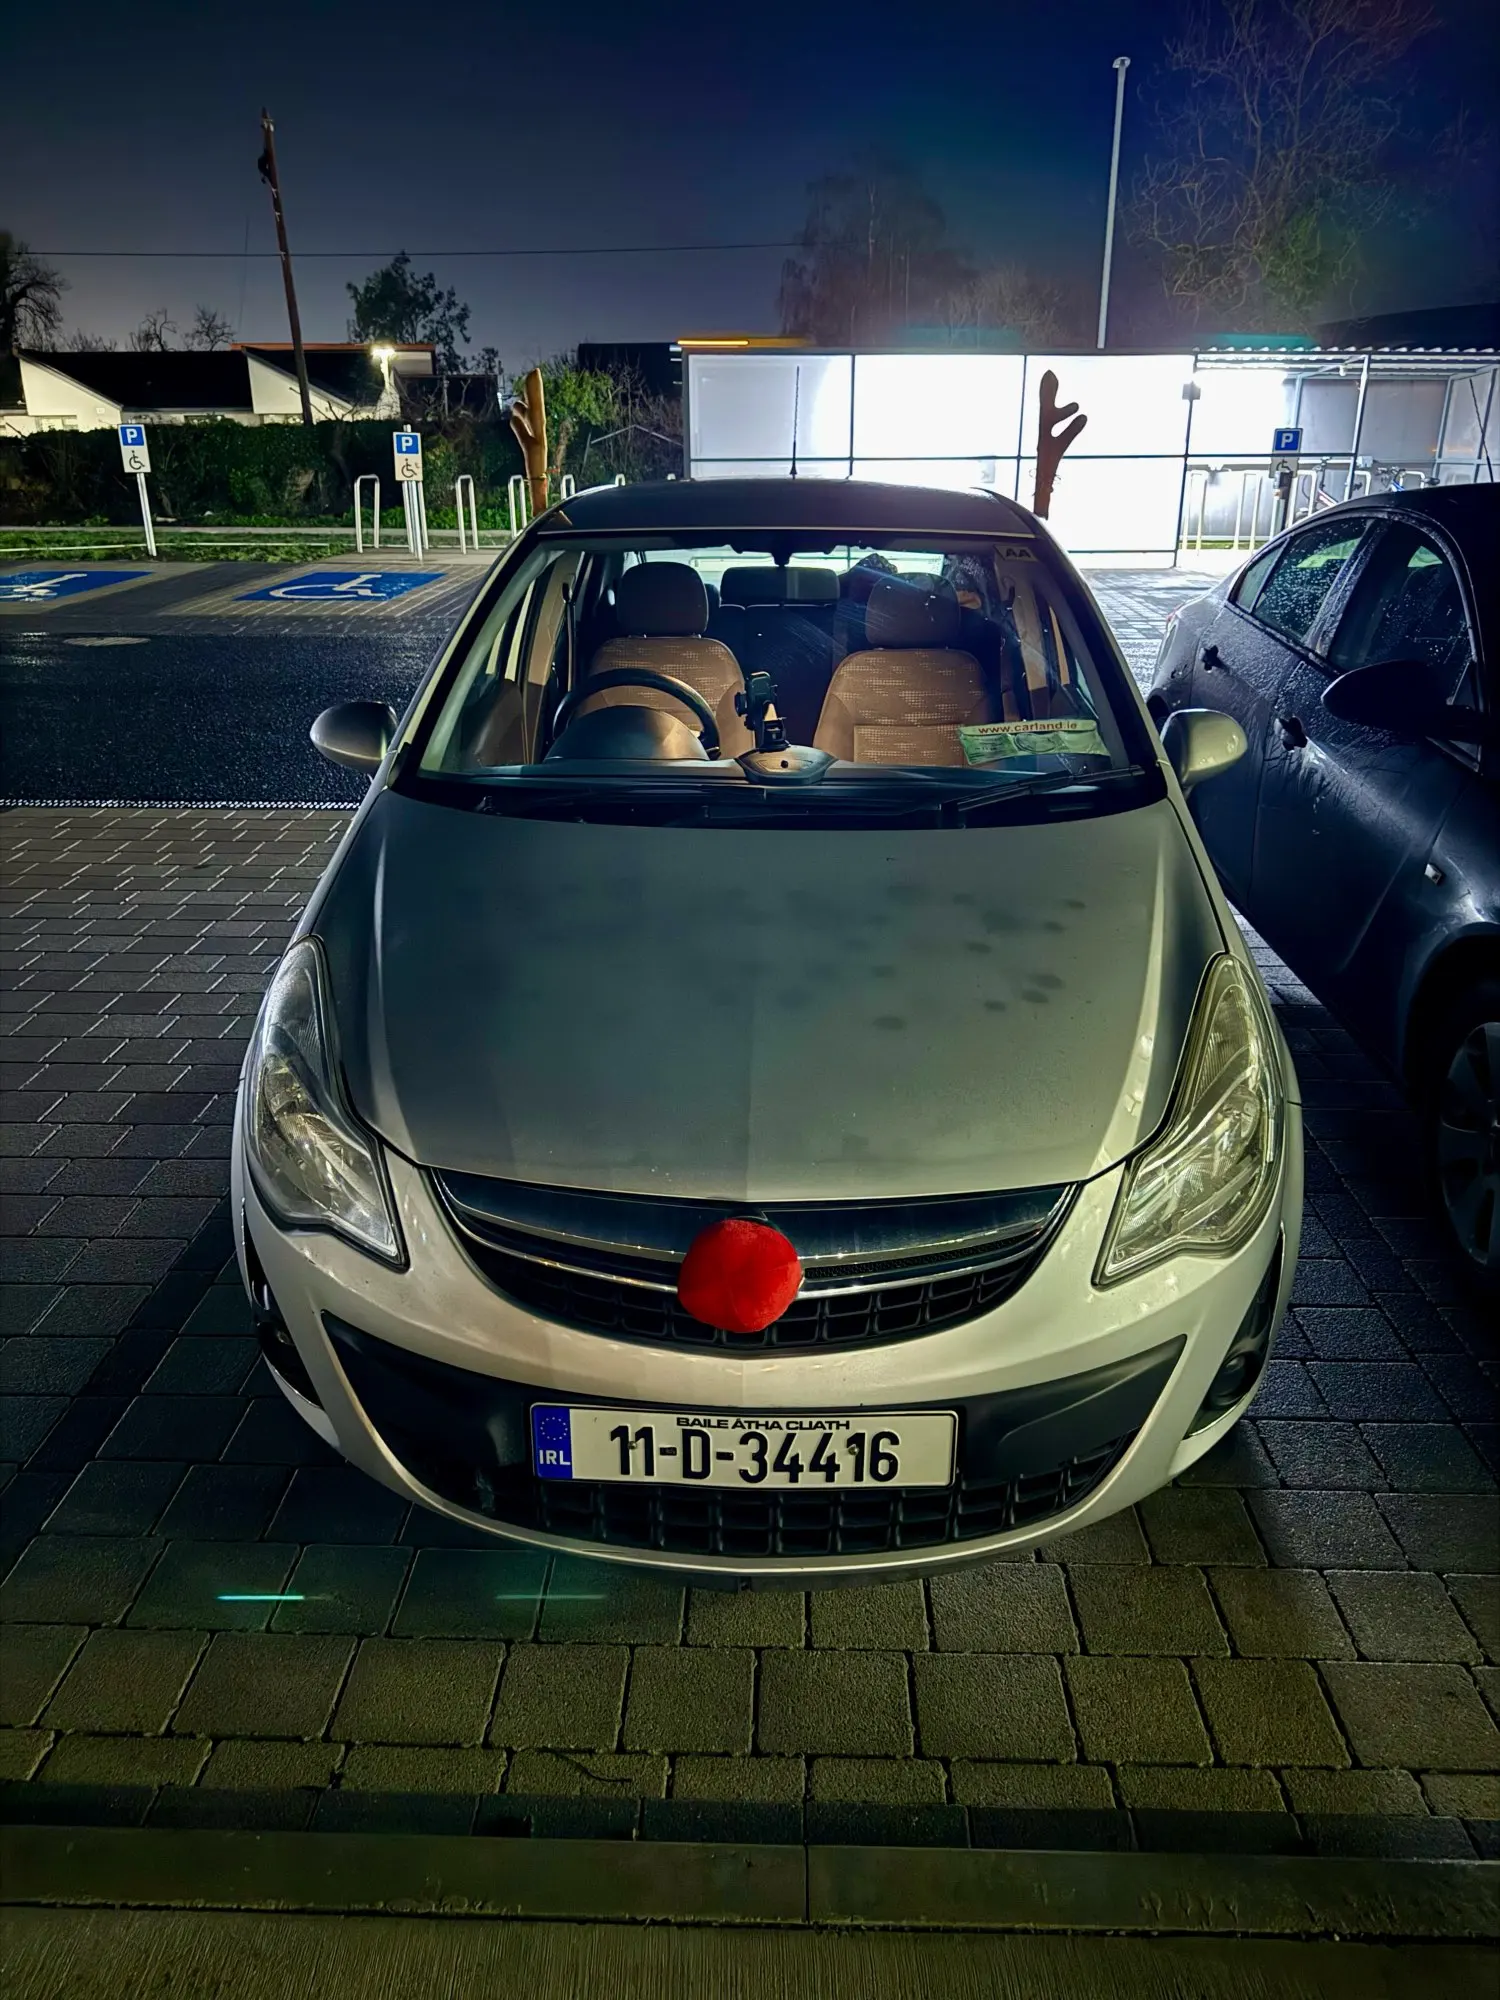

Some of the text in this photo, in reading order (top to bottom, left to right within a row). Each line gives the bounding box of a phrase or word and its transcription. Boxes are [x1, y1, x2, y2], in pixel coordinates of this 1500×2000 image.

[126, 428, 138, 444] P
[401, 436, 413, 452] P
[1280, 433, 1294, 449] P
[1006, 548, 1031, 558] AA
[978, 721, 1077, 735] www.carland.ie
[676, 1417, 729, 1429] BAILE
[786, 1420, 850, 1431] CLIATH
[539, 1449, 571, 1466] IRL
[610, 1424, 900, 1484] 11-D-34416
